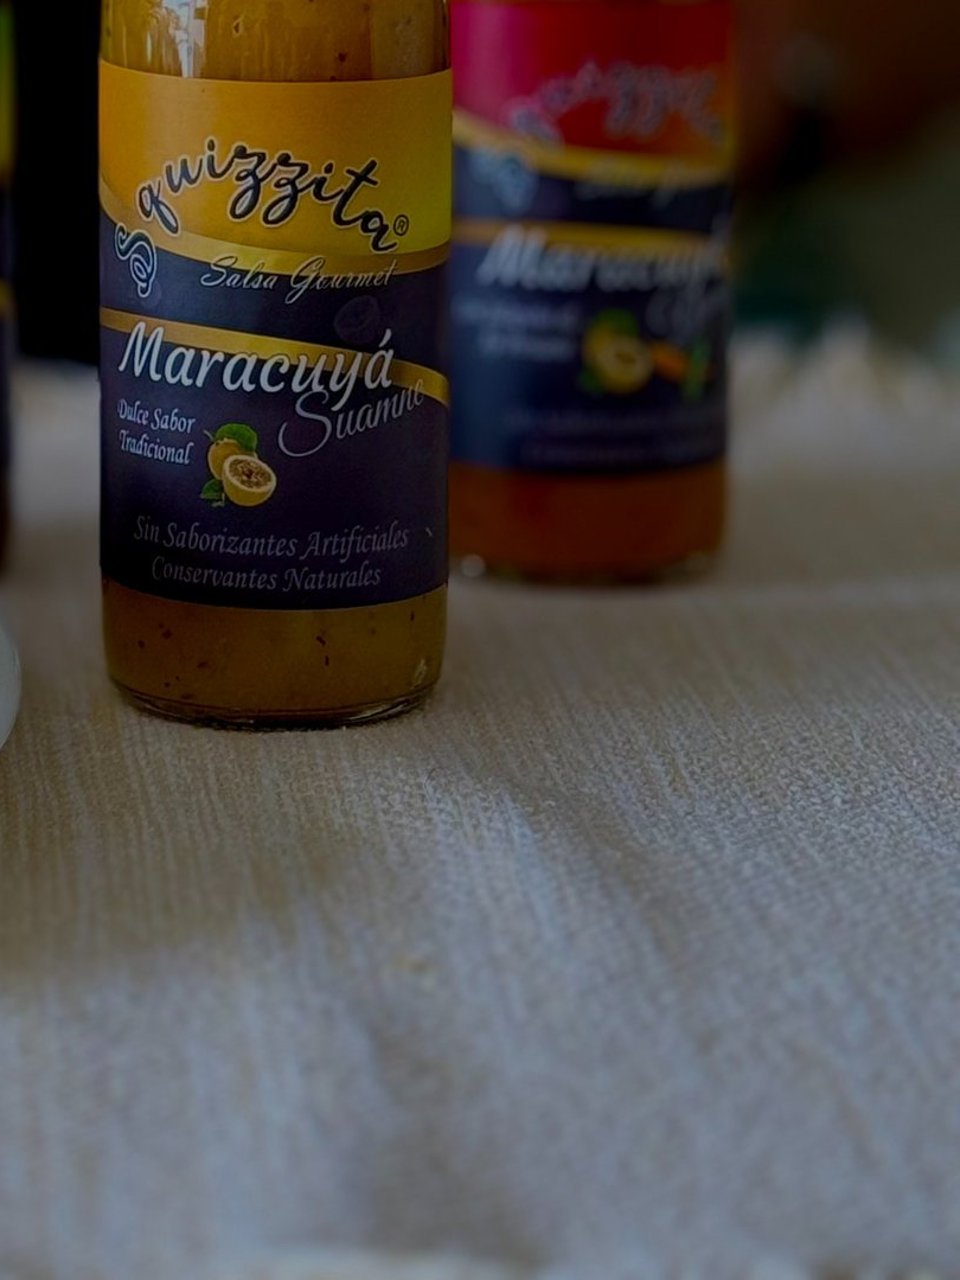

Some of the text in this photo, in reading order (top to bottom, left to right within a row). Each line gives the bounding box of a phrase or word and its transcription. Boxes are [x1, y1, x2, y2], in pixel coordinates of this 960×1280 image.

[201, 256, 396, 304] Salsa Gourmet
[118, 321, 394, 411] Maracuyá
[117, 398, 196, 433] Dulce Sabor
[119, 429, 194, 465] Tradicional
[133, 515, 409, 563] Sin Saborizantes Artificiales
[152, 554, 382, 592] Conservantes Naturales
